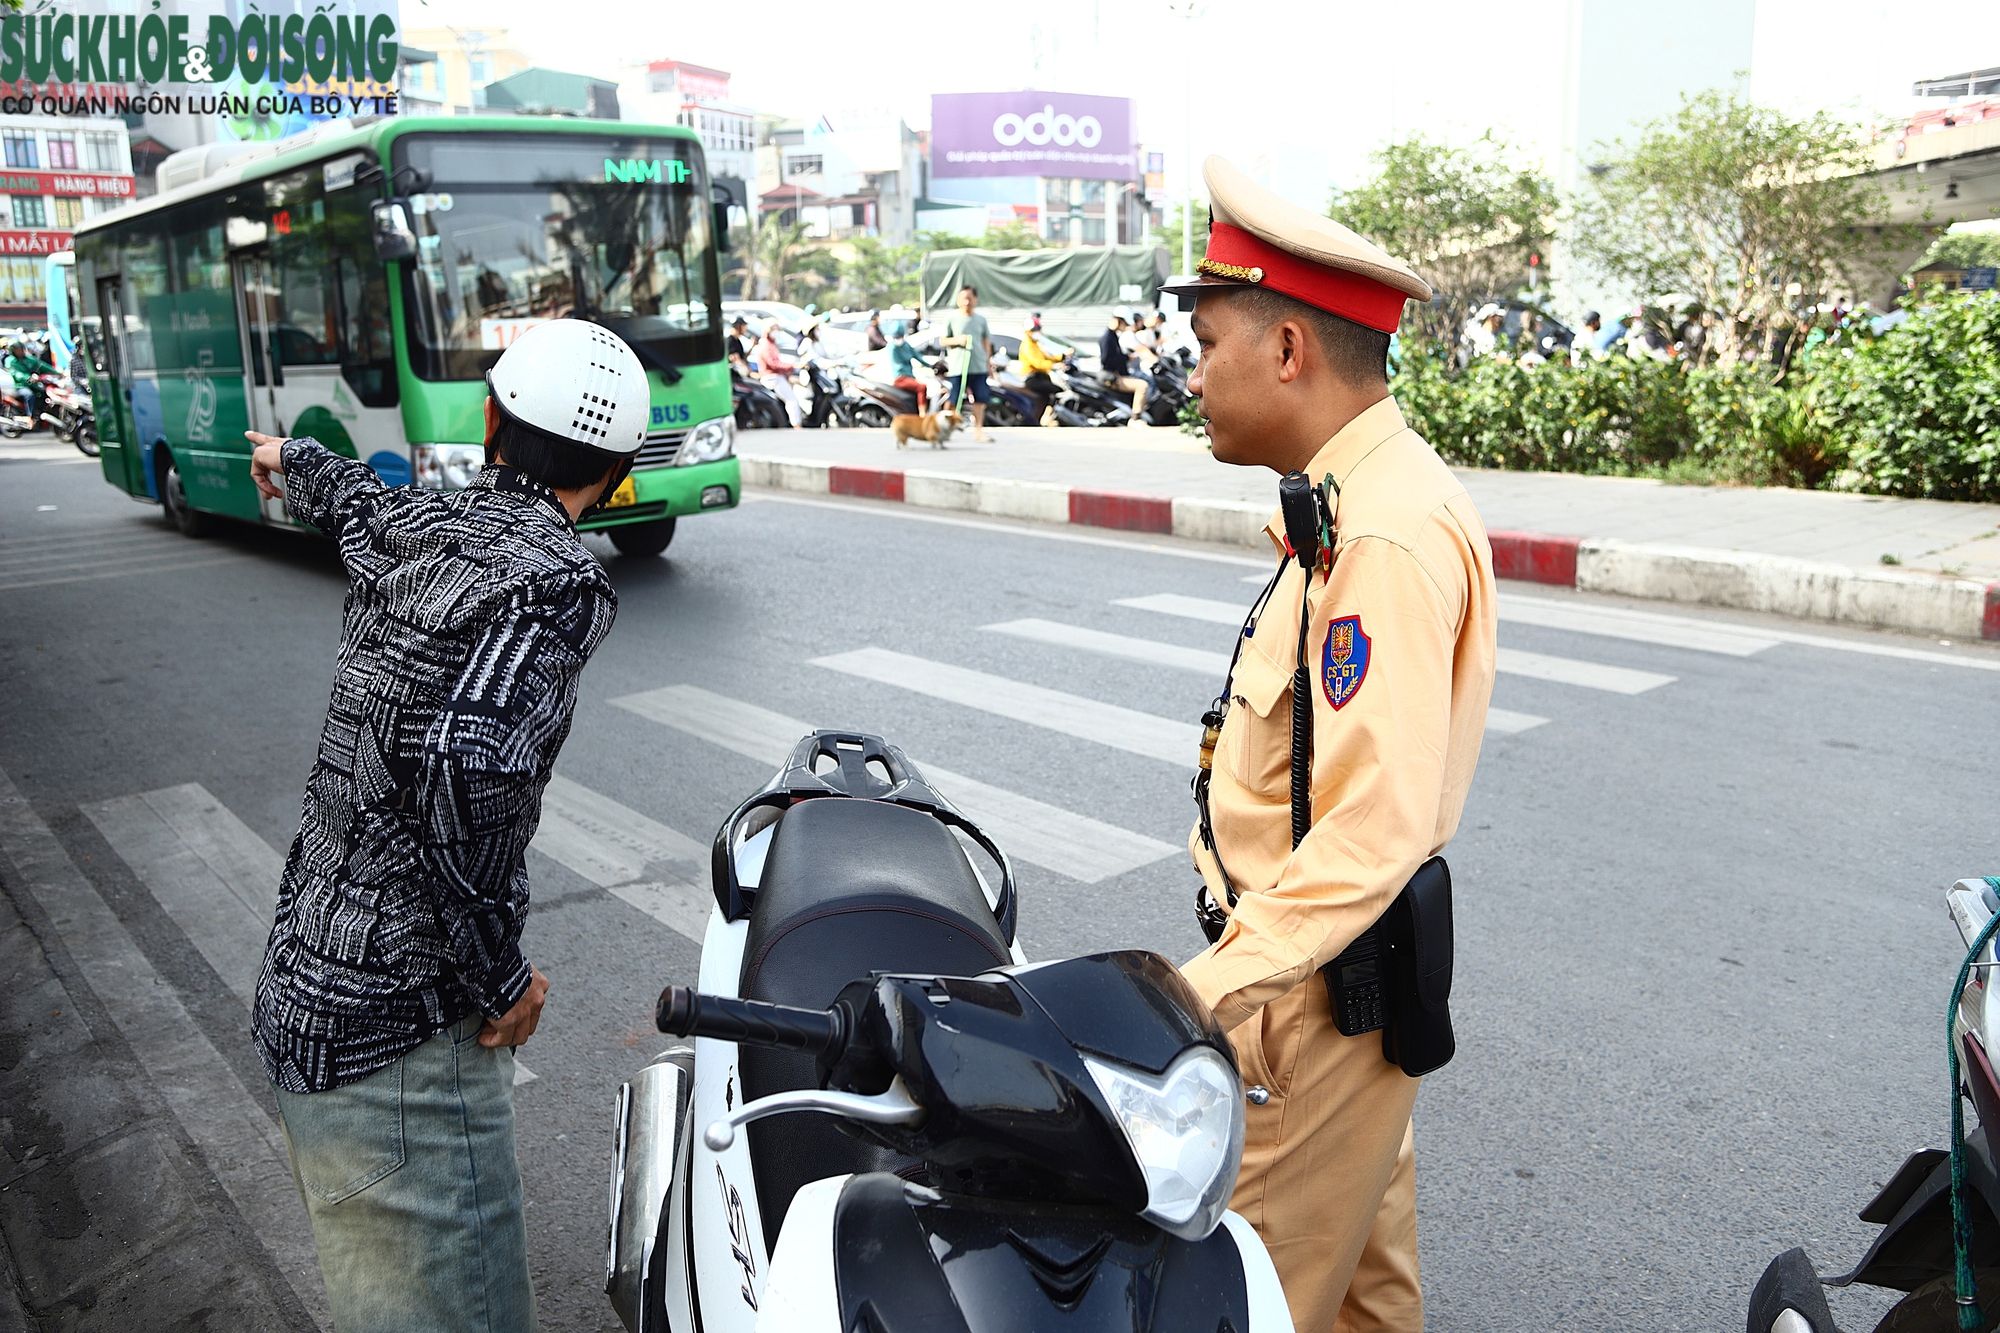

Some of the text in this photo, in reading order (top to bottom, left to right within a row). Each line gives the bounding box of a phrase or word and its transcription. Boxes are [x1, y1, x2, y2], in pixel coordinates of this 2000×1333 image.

[993, 104, 1102, 148] odoo
[604, 158, 662, 183] NAM
[54, 175, 96, 193] HÀNG
[98, 177, 131, 197] HIỆU
[8, 232, 49, 253] MẮT
[651, 403, 690, 425] BUS
[1327, 664, 1357, 678] CS GT
